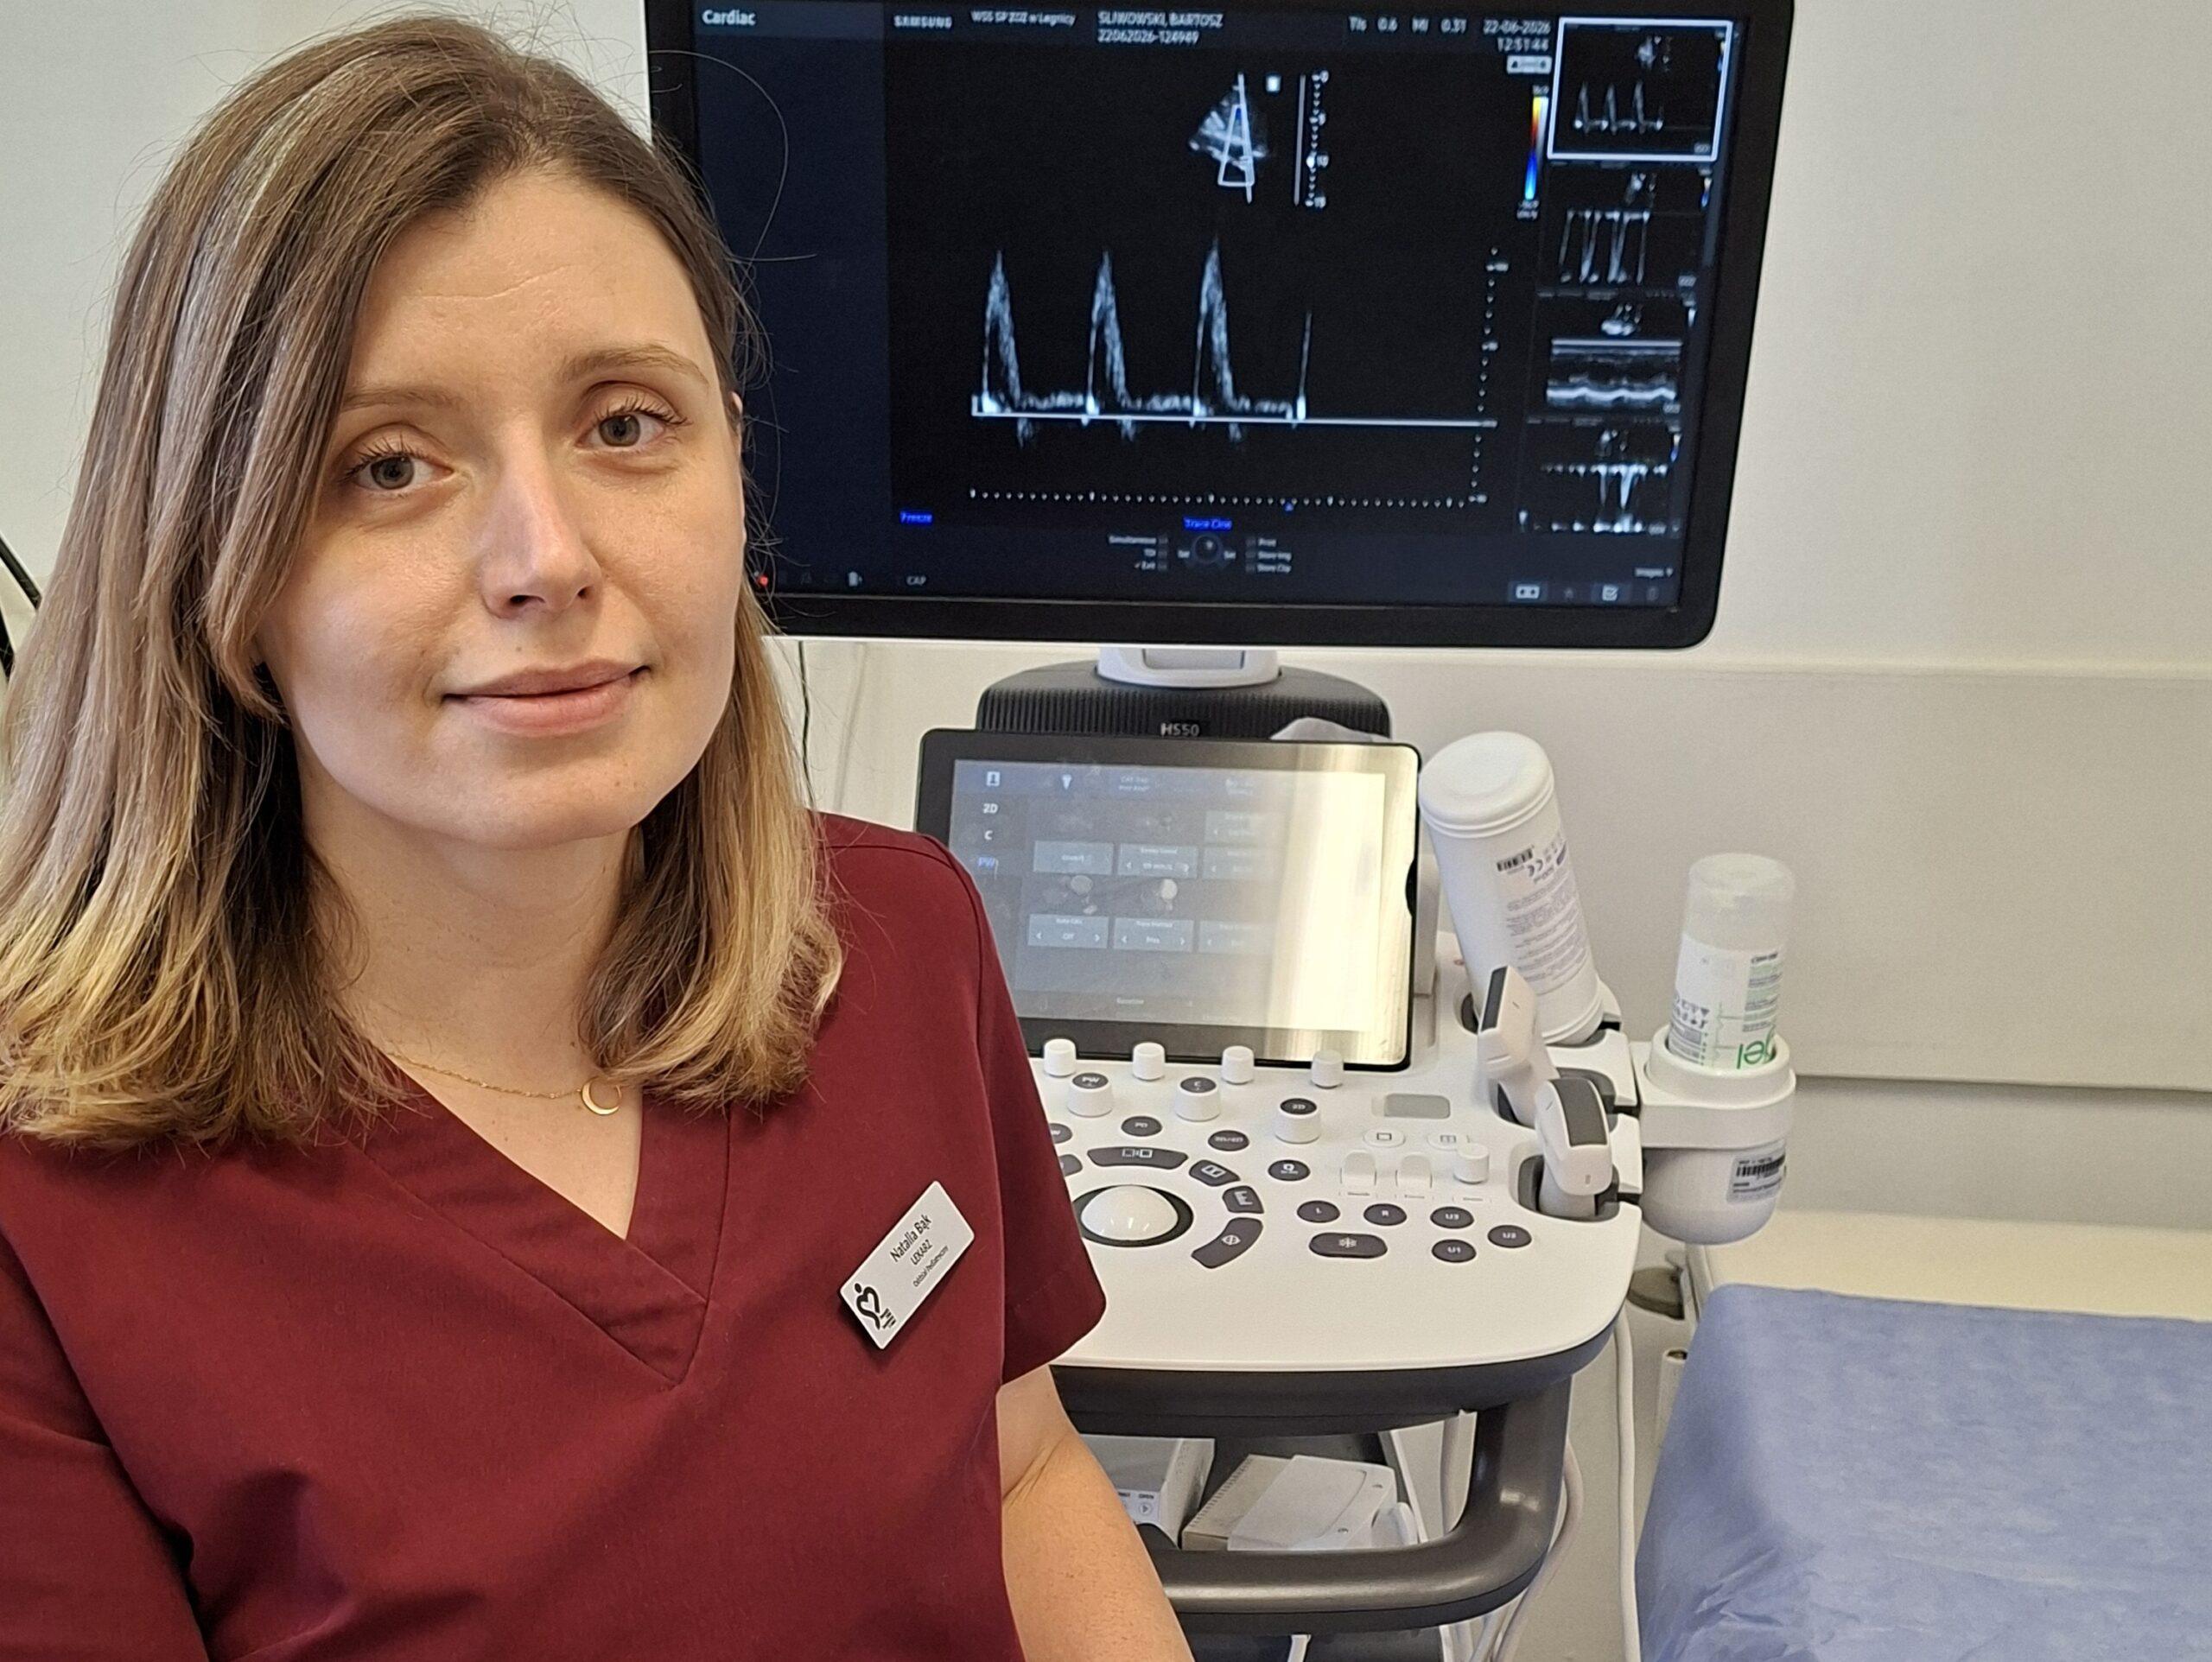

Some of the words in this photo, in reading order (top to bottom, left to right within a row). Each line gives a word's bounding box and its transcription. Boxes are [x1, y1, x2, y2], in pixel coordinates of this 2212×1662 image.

[702, 10, 756, 26] Cardiac
[893, 16, 953, 29] SAMSUNG
[1039, 13, 1077, 27] Legnicy
[1169, 13, 1224, 29] BARTOSZ
[982, 803, 999, 815] 2D
[984, 829, 994, 841] C
[890, 1231, 918, 1262] Natalia
[914, 1215, 932, 1234] Bąk
[910, 1240, 932, 1265] LEKARZ
